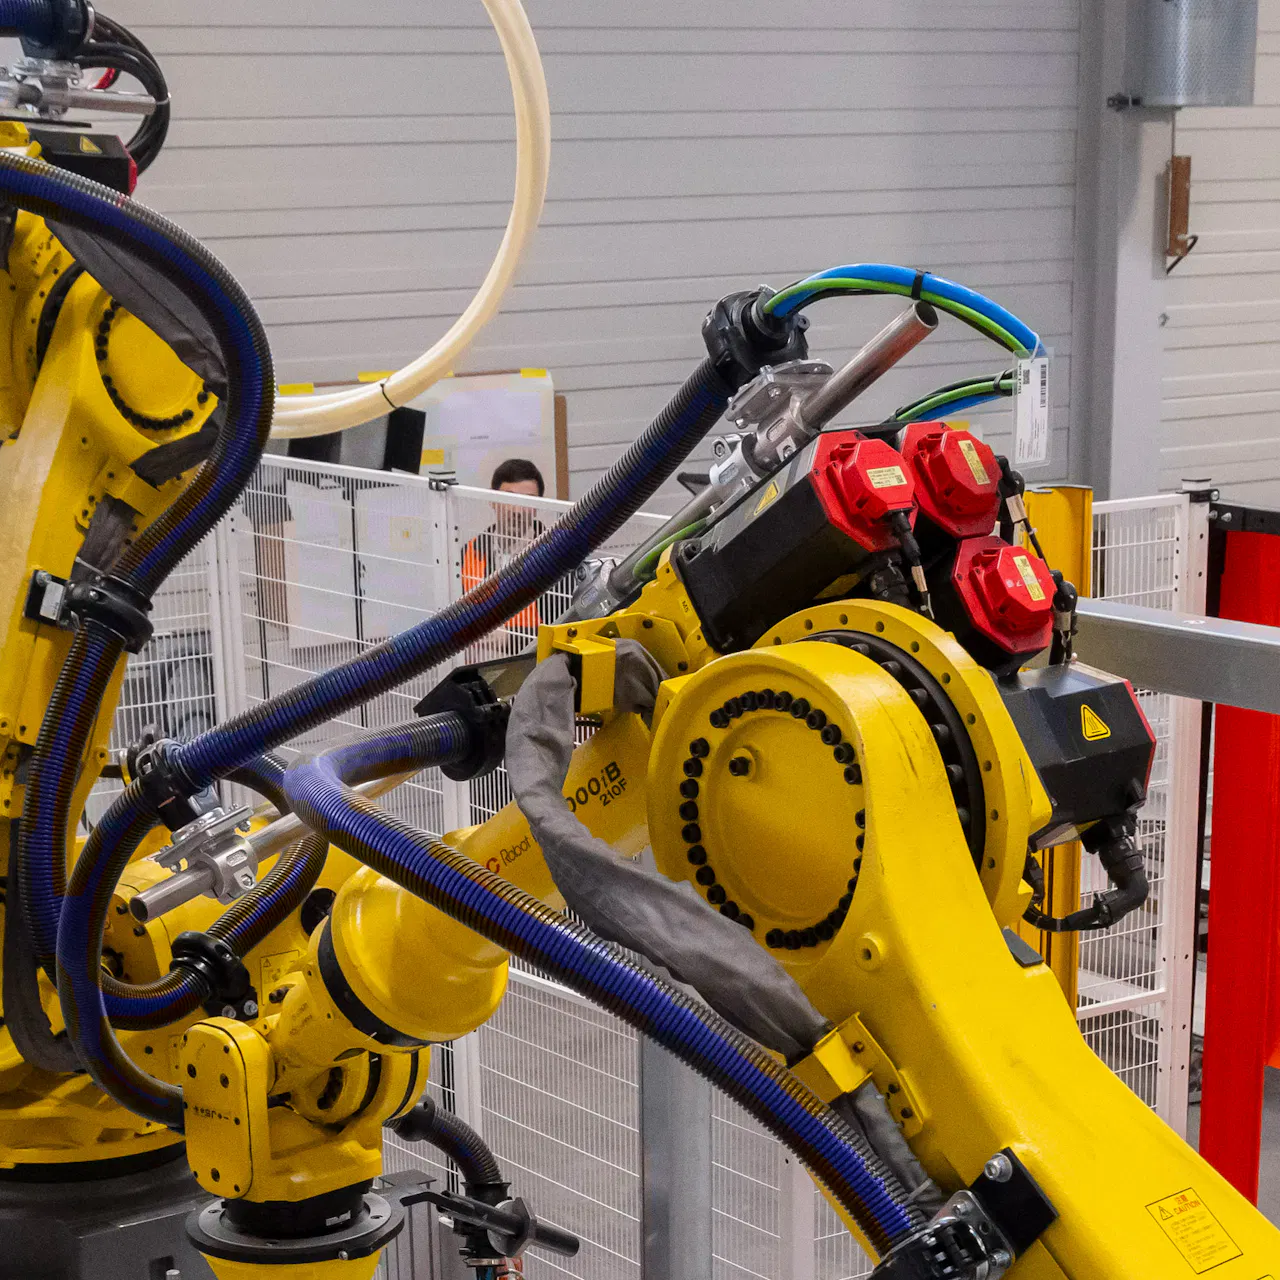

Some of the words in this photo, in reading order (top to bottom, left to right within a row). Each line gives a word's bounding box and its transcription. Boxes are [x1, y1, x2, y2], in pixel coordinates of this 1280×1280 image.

[599, 778, 627, 806] 210F
[499, 835, 532, 867] Robot
[1173, 1200, 1201, 1215] CAUTION
